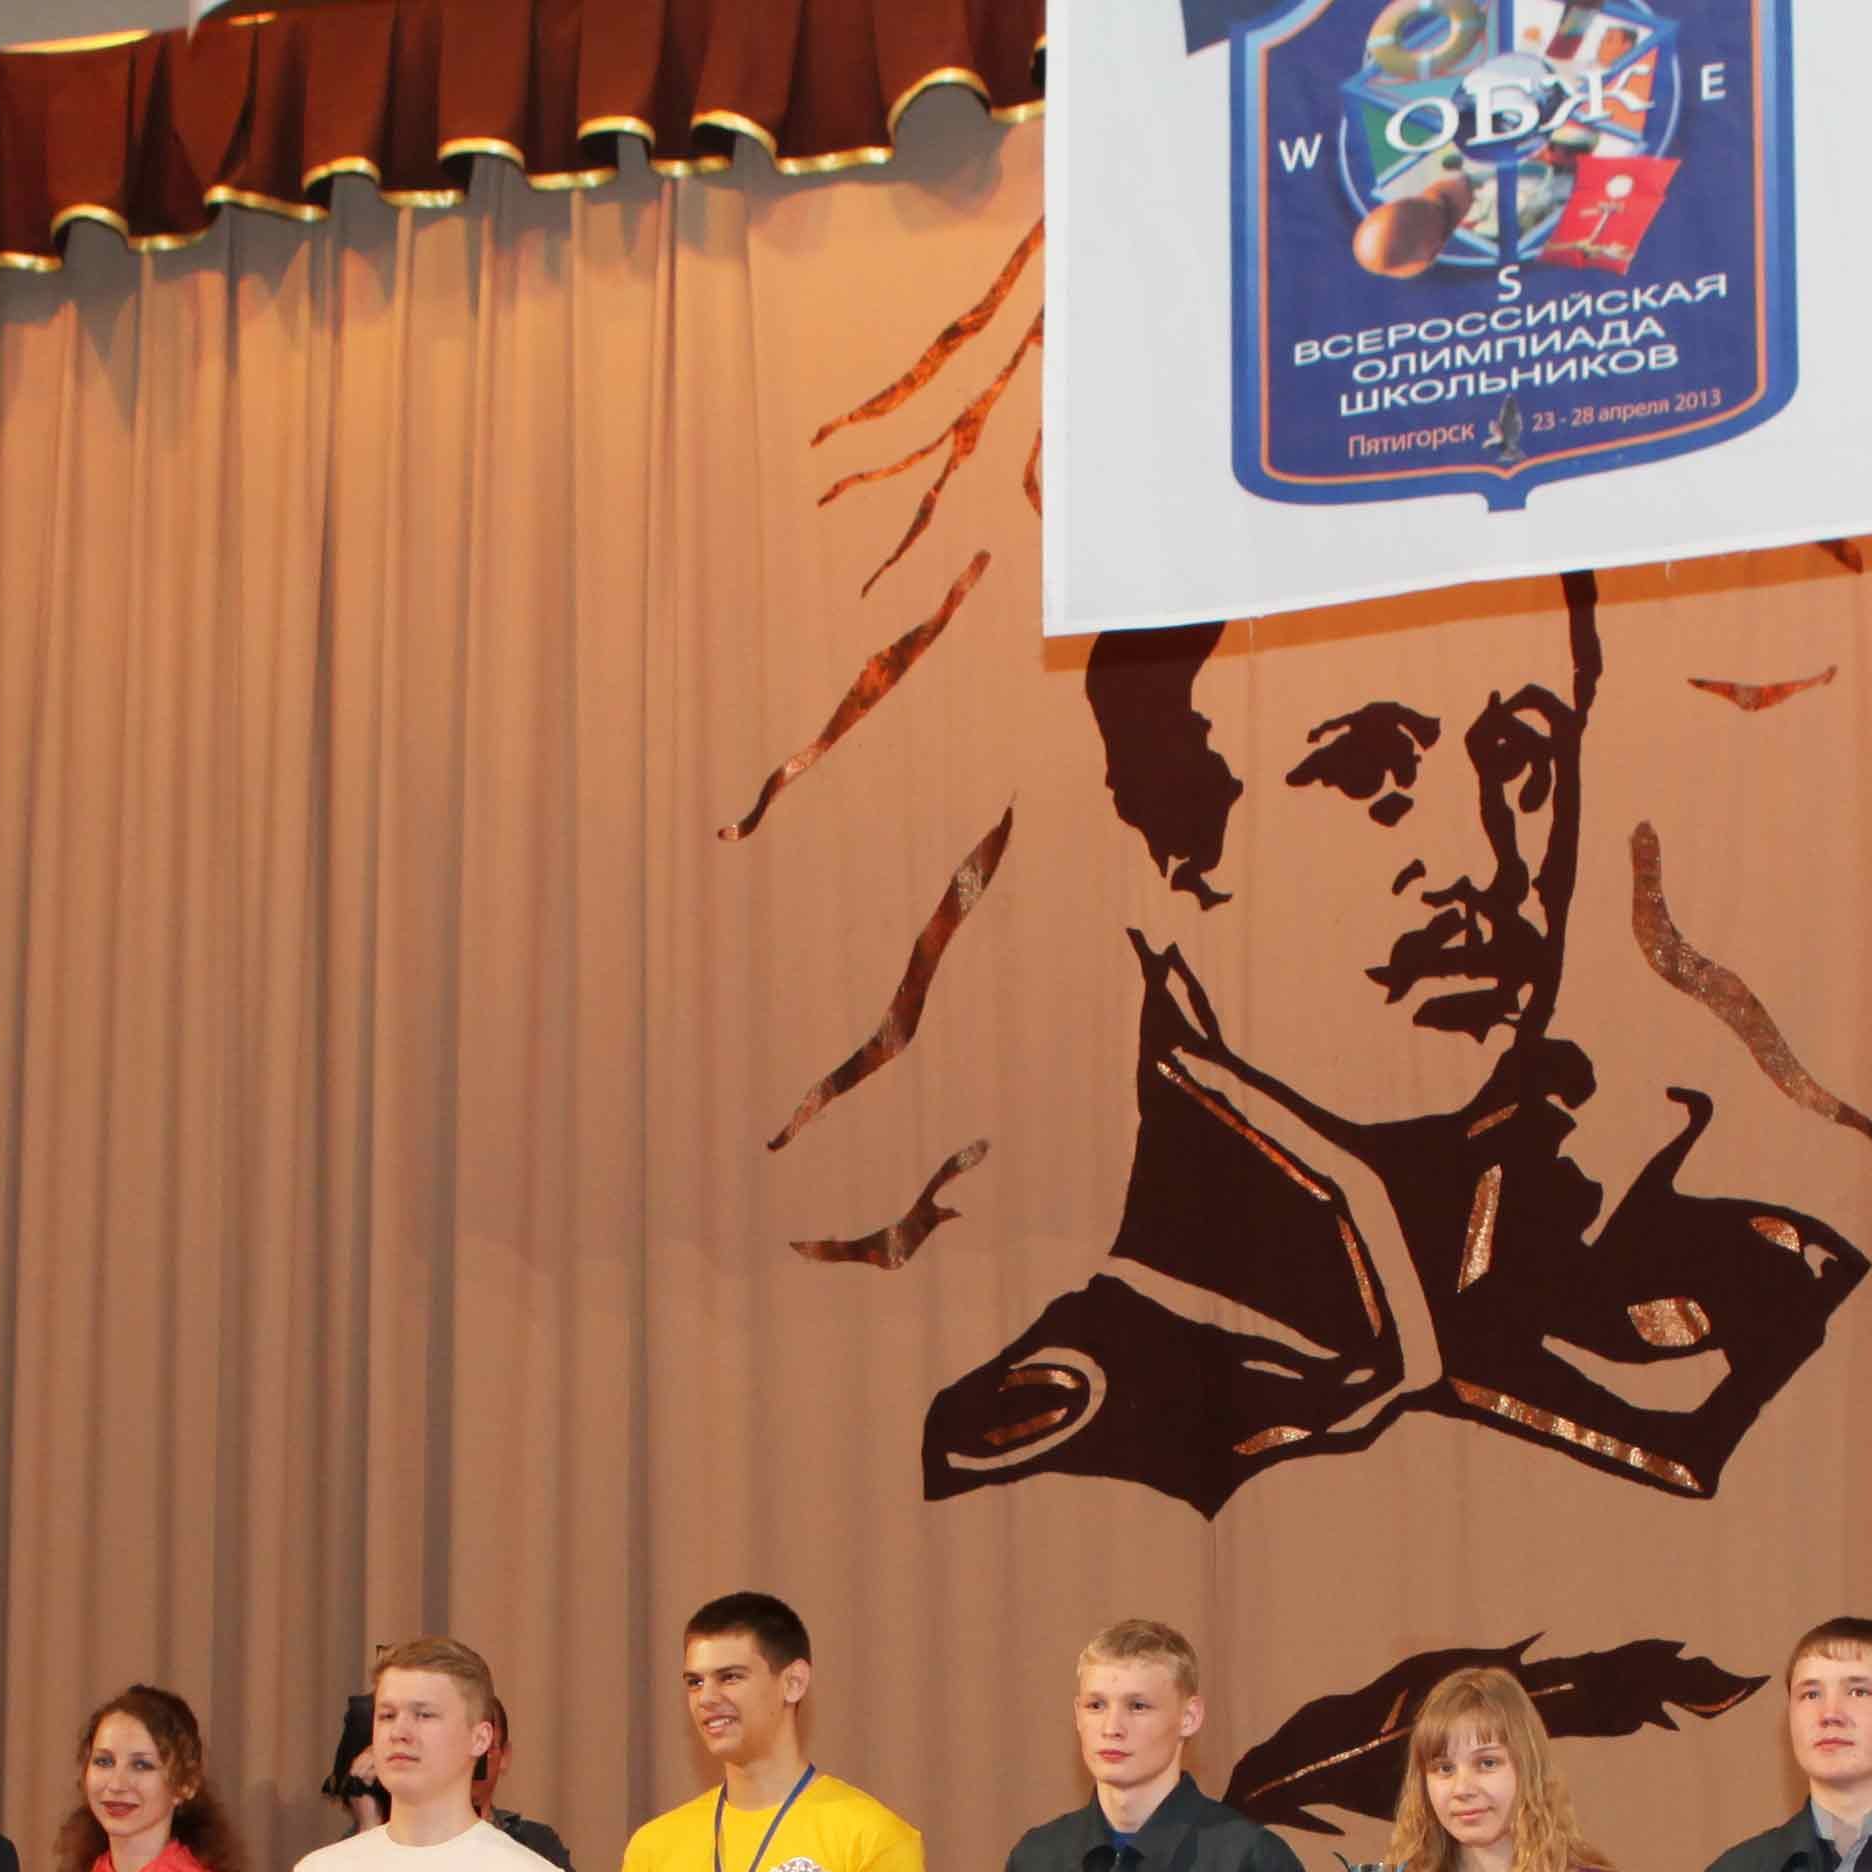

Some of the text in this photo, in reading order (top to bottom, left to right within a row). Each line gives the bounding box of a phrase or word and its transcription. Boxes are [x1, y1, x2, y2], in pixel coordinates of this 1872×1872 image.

[1700, 62, 1727, 101] E
[1384, 63, 1656, 152] ОБЖ
[1278, 132, 1323, 173] W
[1497, 263, 1523, 302] S
[1293, 272, 1728, 367] ВСЕРОССИЙСКАЯ
[1351, 316, 1666, 384] ОЛИМПИАДА
[1339, 343, 1680, 417] ШКОЛЬНИКОВ
[1531, 411, 1557, 433] 23
[1570, 407, 1596, 427] 28
[1598, 397, 1671, 427] апреля
[1673, 388, 1723, 413] 2013
[1347, 420, 1476, 459] Пятигорск
